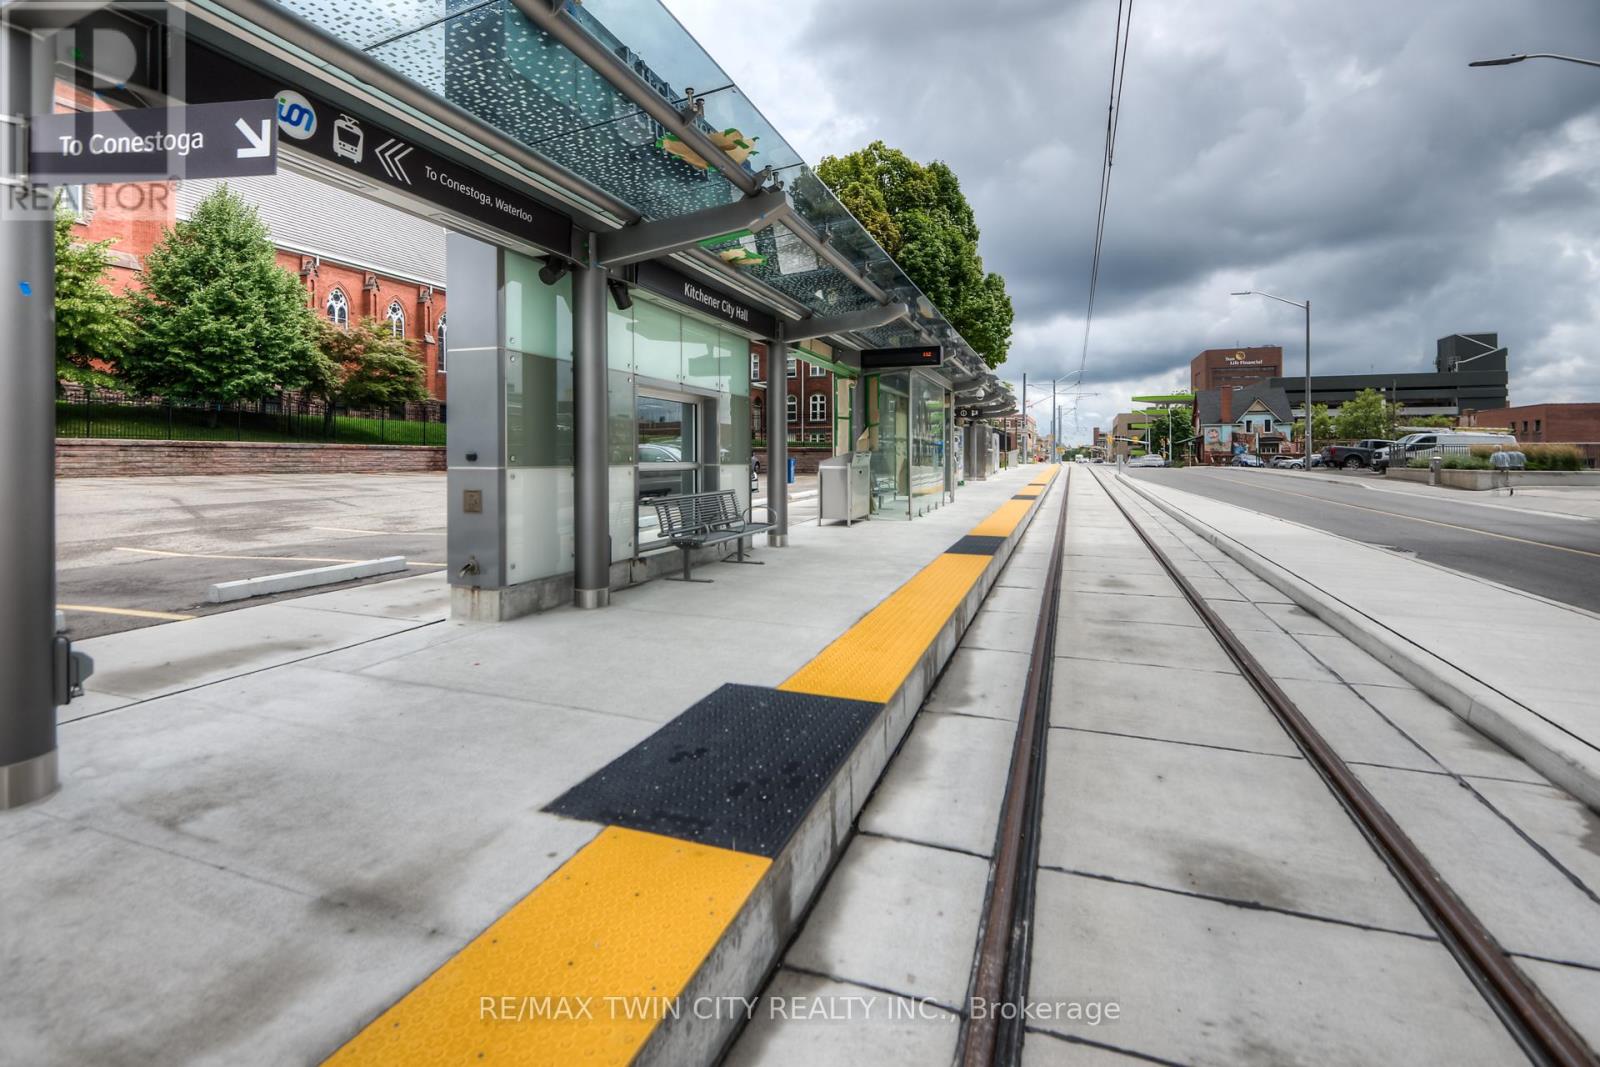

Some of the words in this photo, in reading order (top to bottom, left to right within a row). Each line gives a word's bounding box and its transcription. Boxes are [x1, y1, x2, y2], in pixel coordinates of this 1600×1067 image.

[59, 136, 83, 156] To
[90, 131, 204, 156] Conestoga
[425, 166, 437, 180] To
[440, 173, 493, 207] Conestoga,
[495, 197, 533, 223] Waterloo
[684, 282, 720, 309] Kitchener
[721, 300, 735, 318] City
[736, 306, 749, 321] Hall
